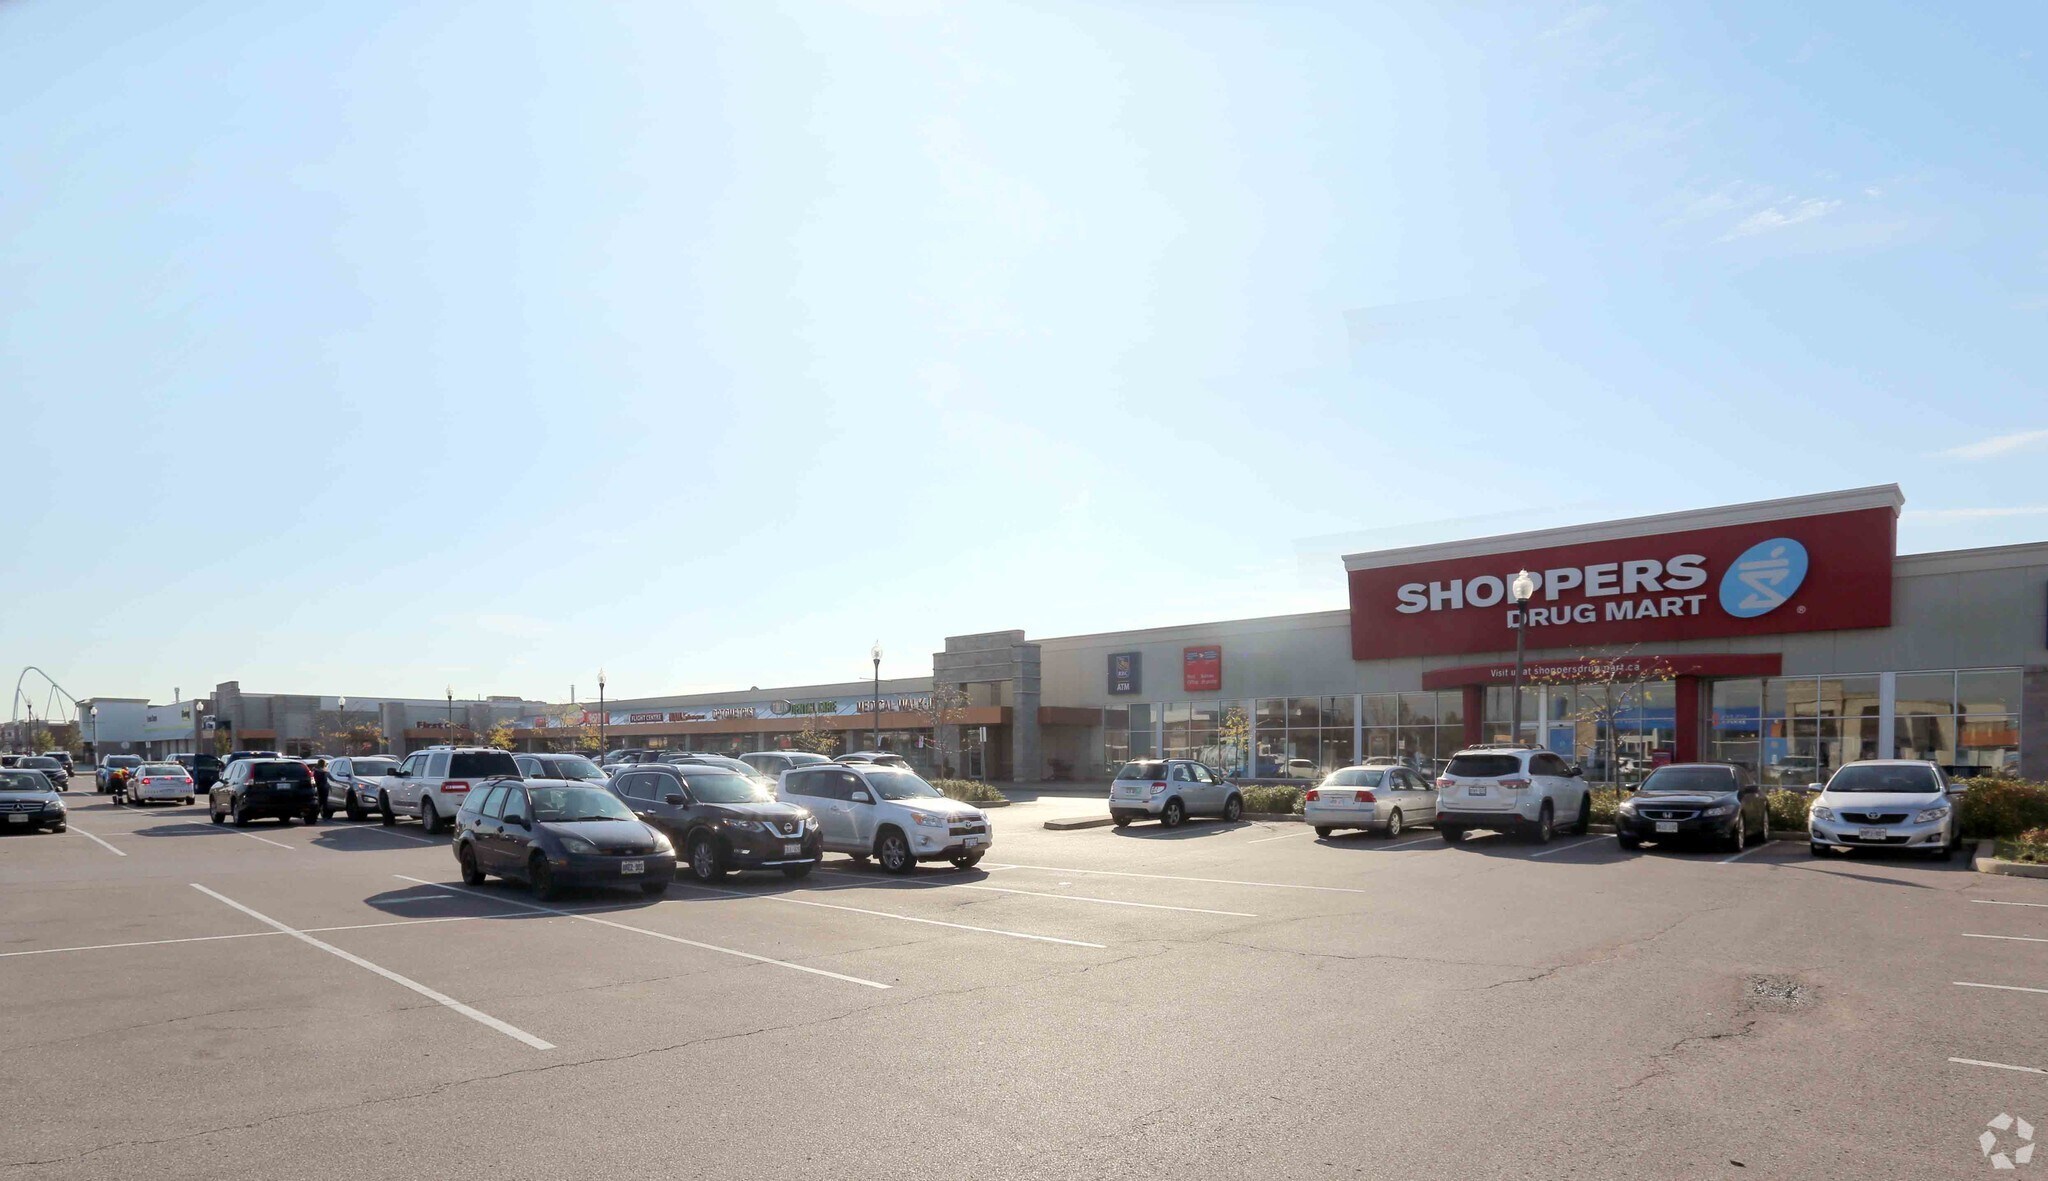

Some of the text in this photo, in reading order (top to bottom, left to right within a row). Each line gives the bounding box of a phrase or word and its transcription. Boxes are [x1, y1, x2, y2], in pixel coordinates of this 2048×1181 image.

[1395, 554, 1708, 614] SHOPPERS
[1507, 595, 1707, 629] DRUG MART
[1491, 668, 1508, 677] Visit
[1523, 668, 1531, 676] at
[1117, 683, 1130, 691] ATM
[898, 697, 935, 711] WALK-I
[631, 714, 646, 722] FLIGHT
[646, 713, 662, 721] CENTRE
